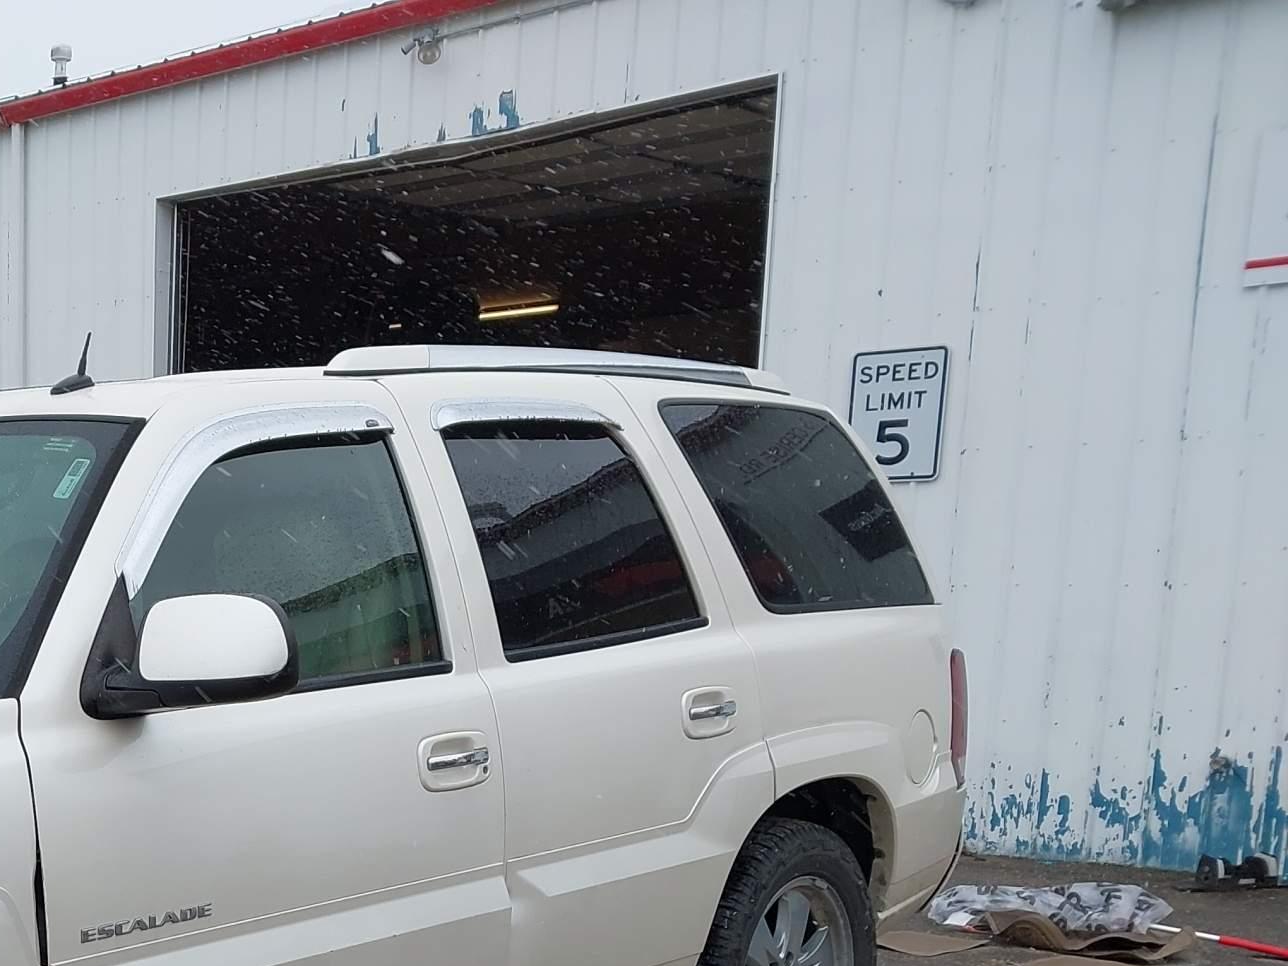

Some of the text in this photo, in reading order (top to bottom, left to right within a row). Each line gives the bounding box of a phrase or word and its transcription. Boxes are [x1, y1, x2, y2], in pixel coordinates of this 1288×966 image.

[859, 361, 939, 384] SPEED
[865, 390, 928, 412] LIMIT
[875, 418, 910, 466] 5
[80, 902, 213, 944] ESCALADE
